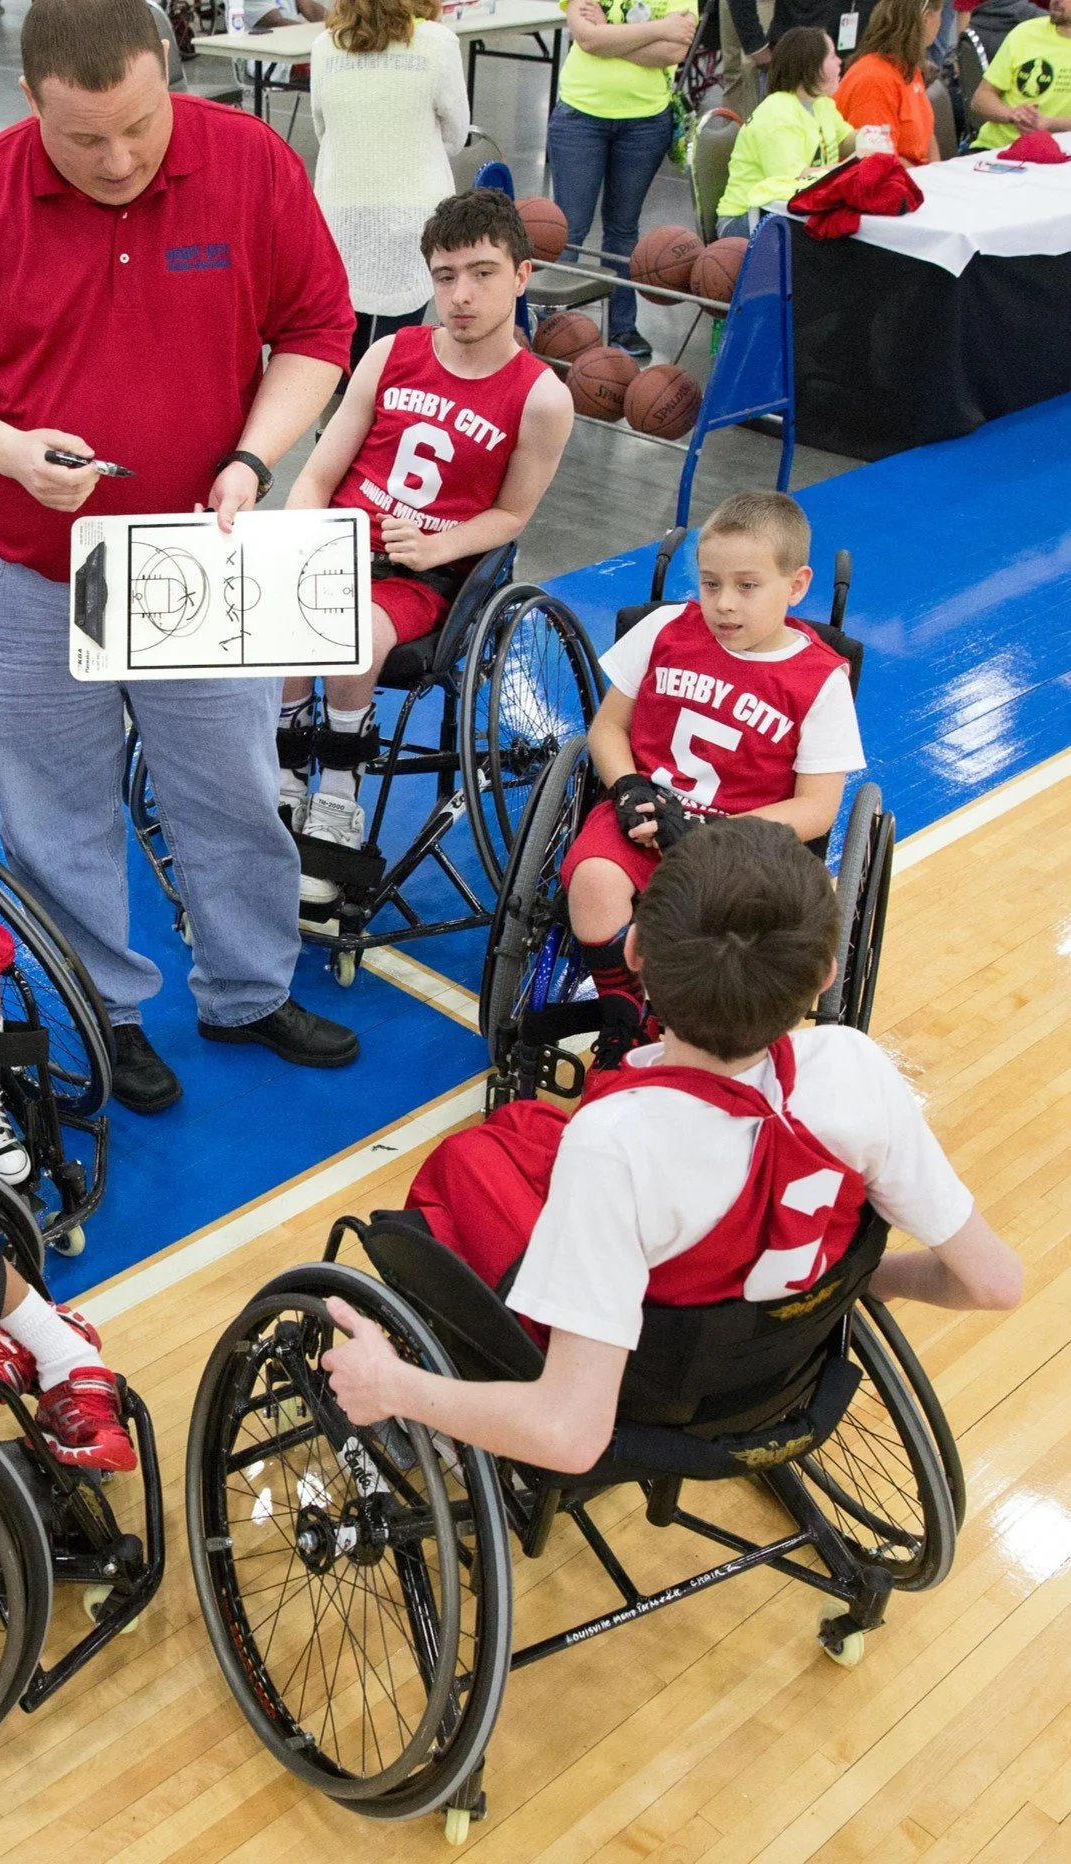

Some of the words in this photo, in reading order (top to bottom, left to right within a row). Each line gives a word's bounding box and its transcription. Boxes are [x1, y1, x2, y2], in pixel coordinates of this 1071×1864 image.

[383, 387, 456, 422] DERBY
[453, 408, 507, 452] CITY
[387, 421, 455, 510] 6
[655, 667, 734, 710] DERBY
[732, 692, 795, 744] CITY
[650, 706, 743, 807] 5
[564, 1618, 611, 1645] Louisville
[690, 1571, 726, 1589] CHAIR
